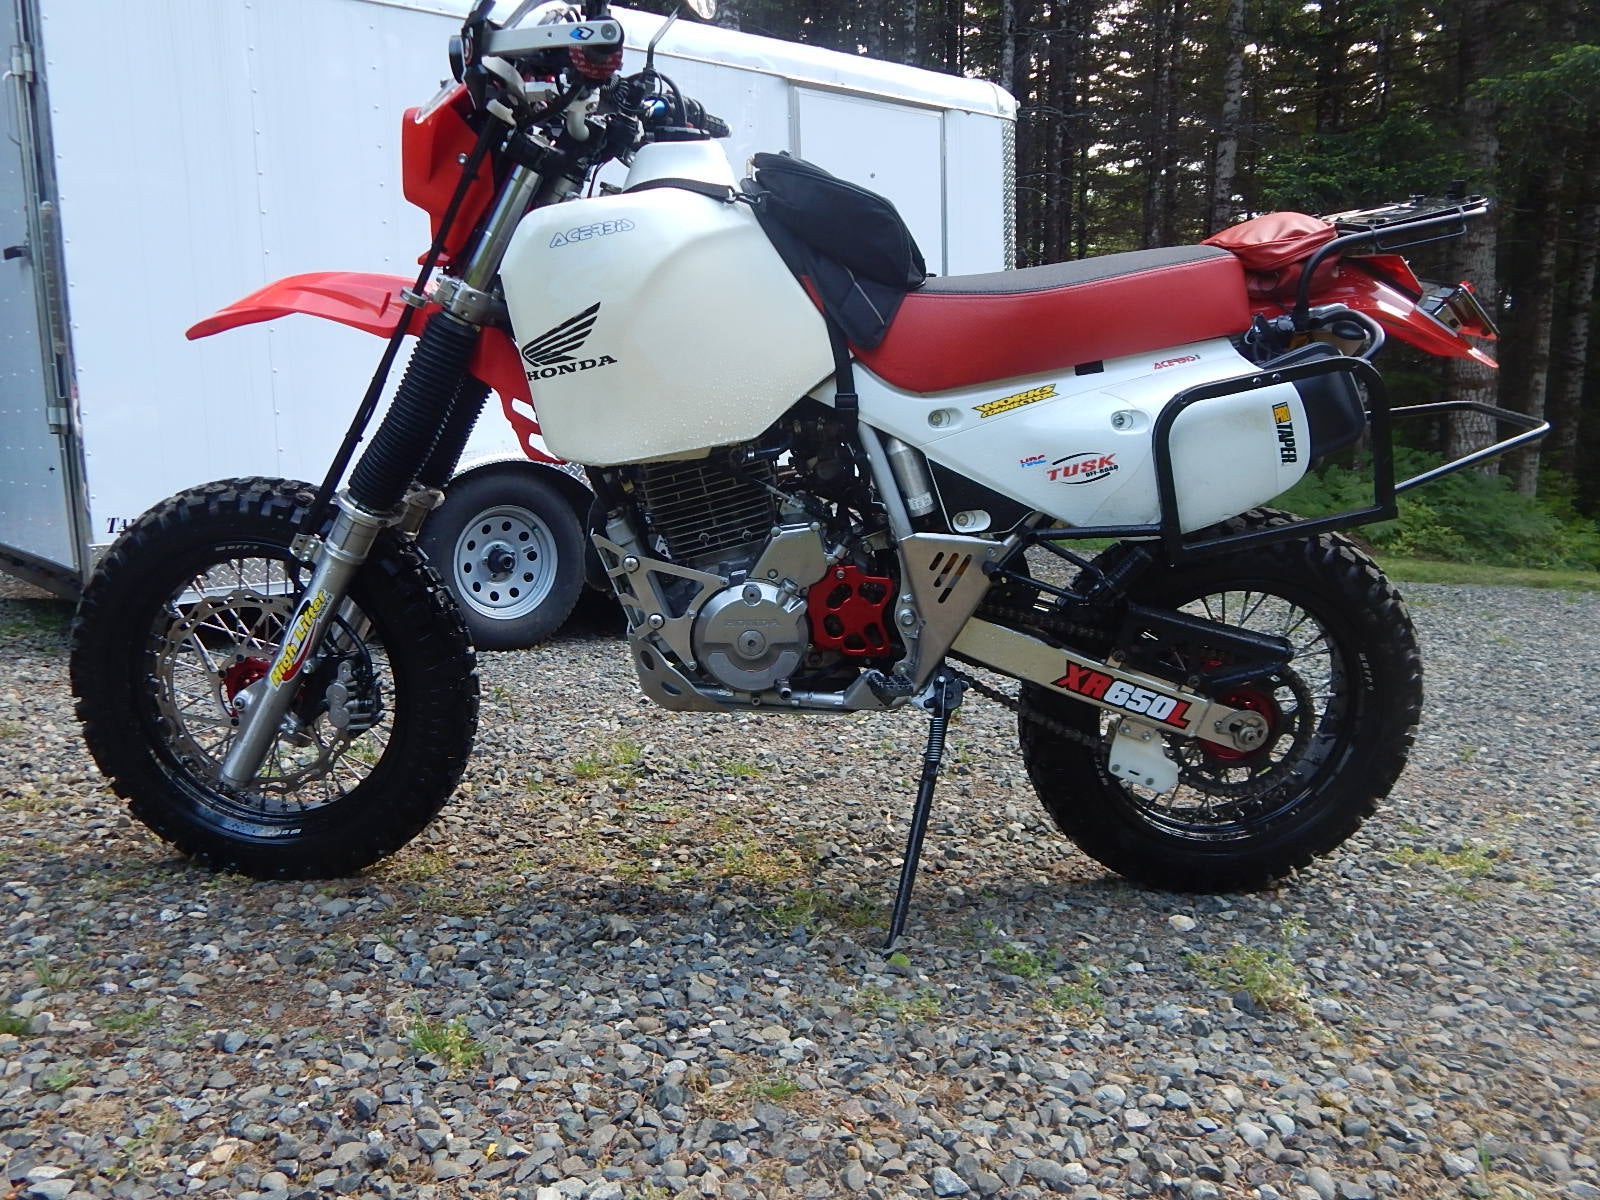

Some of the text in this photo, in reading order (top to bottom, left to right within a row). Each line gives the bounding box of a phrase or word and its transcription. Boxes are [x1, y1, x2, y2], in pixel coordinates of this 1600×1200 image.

[526, 355, 618, 381] HONDA
[973, 384, 1056, 412] WORKS
[981, 391, 1060, 418] CONNECTION
[1276, 422, 1297, 463] TAPER
[1047, 453, 1116, 481] TUSK
[1085, 464, 1119, 478] OFF-ROAD
[270, 590, 325, 688] High Lifter
[1051, 660, 1192, 729] XR650L
